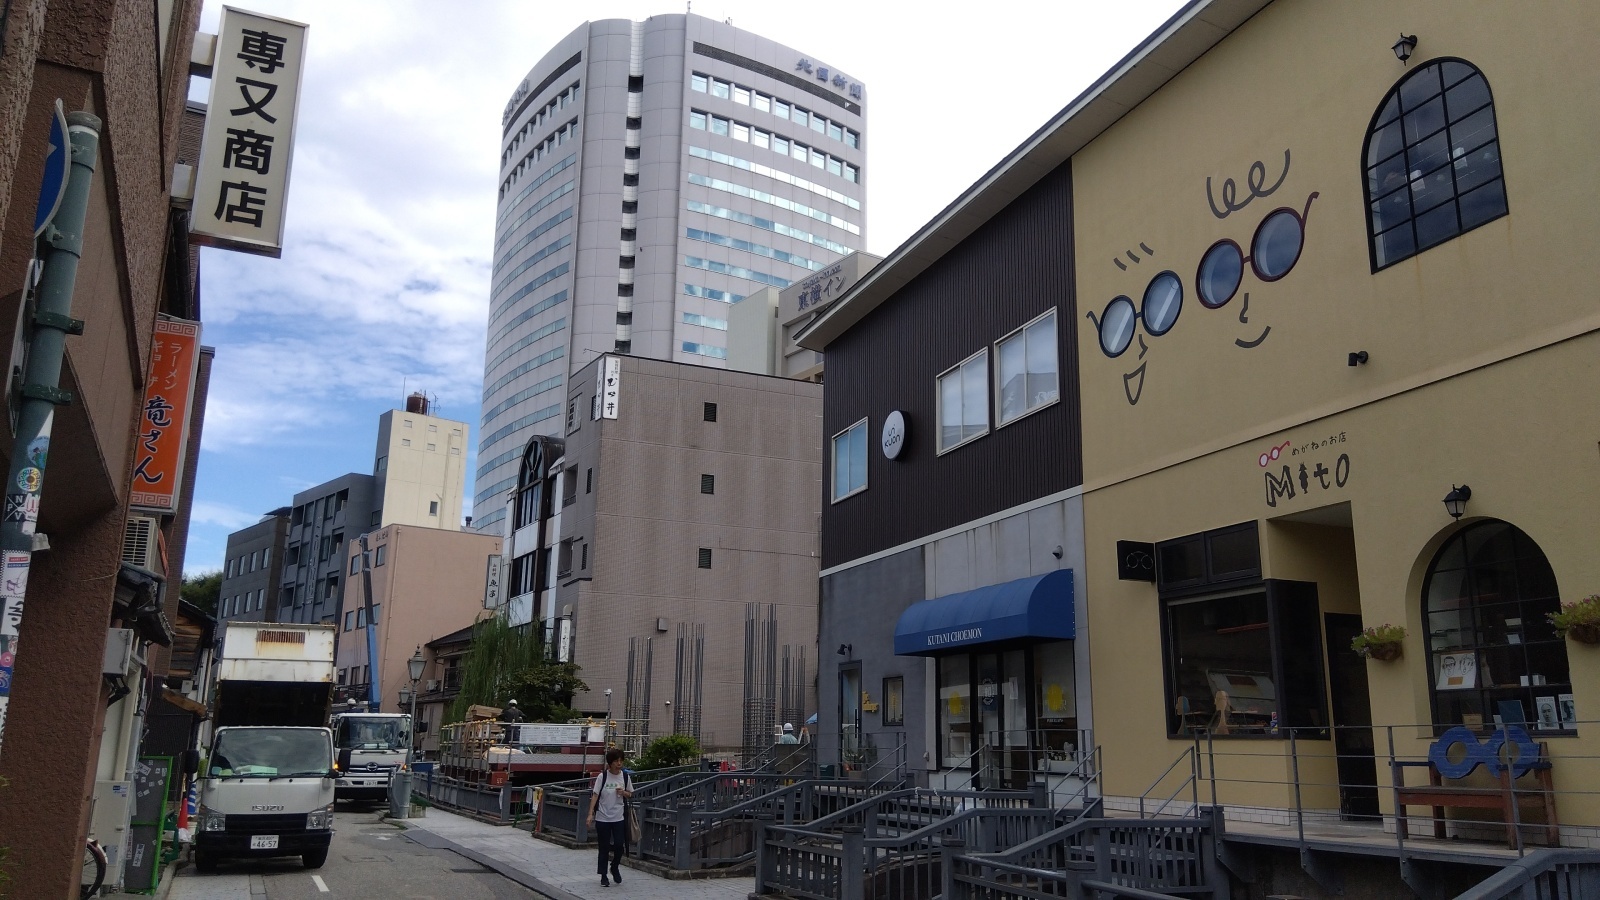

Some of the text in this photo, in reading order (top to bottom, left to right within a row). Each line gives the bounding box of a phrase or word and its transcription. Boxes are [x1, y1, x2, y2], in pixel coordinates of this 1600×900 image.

[214, 28, 288, 229] 専又商店
[164, 342, 183, 391] ラーメン
[133, 394, 175, 485] 竜さん
[1291, 431, 1347, 456] めがねのお店
[927, 627, 983, 646] KUTANI CHOEMON
[251, 804, 285, 812] ISUZU
